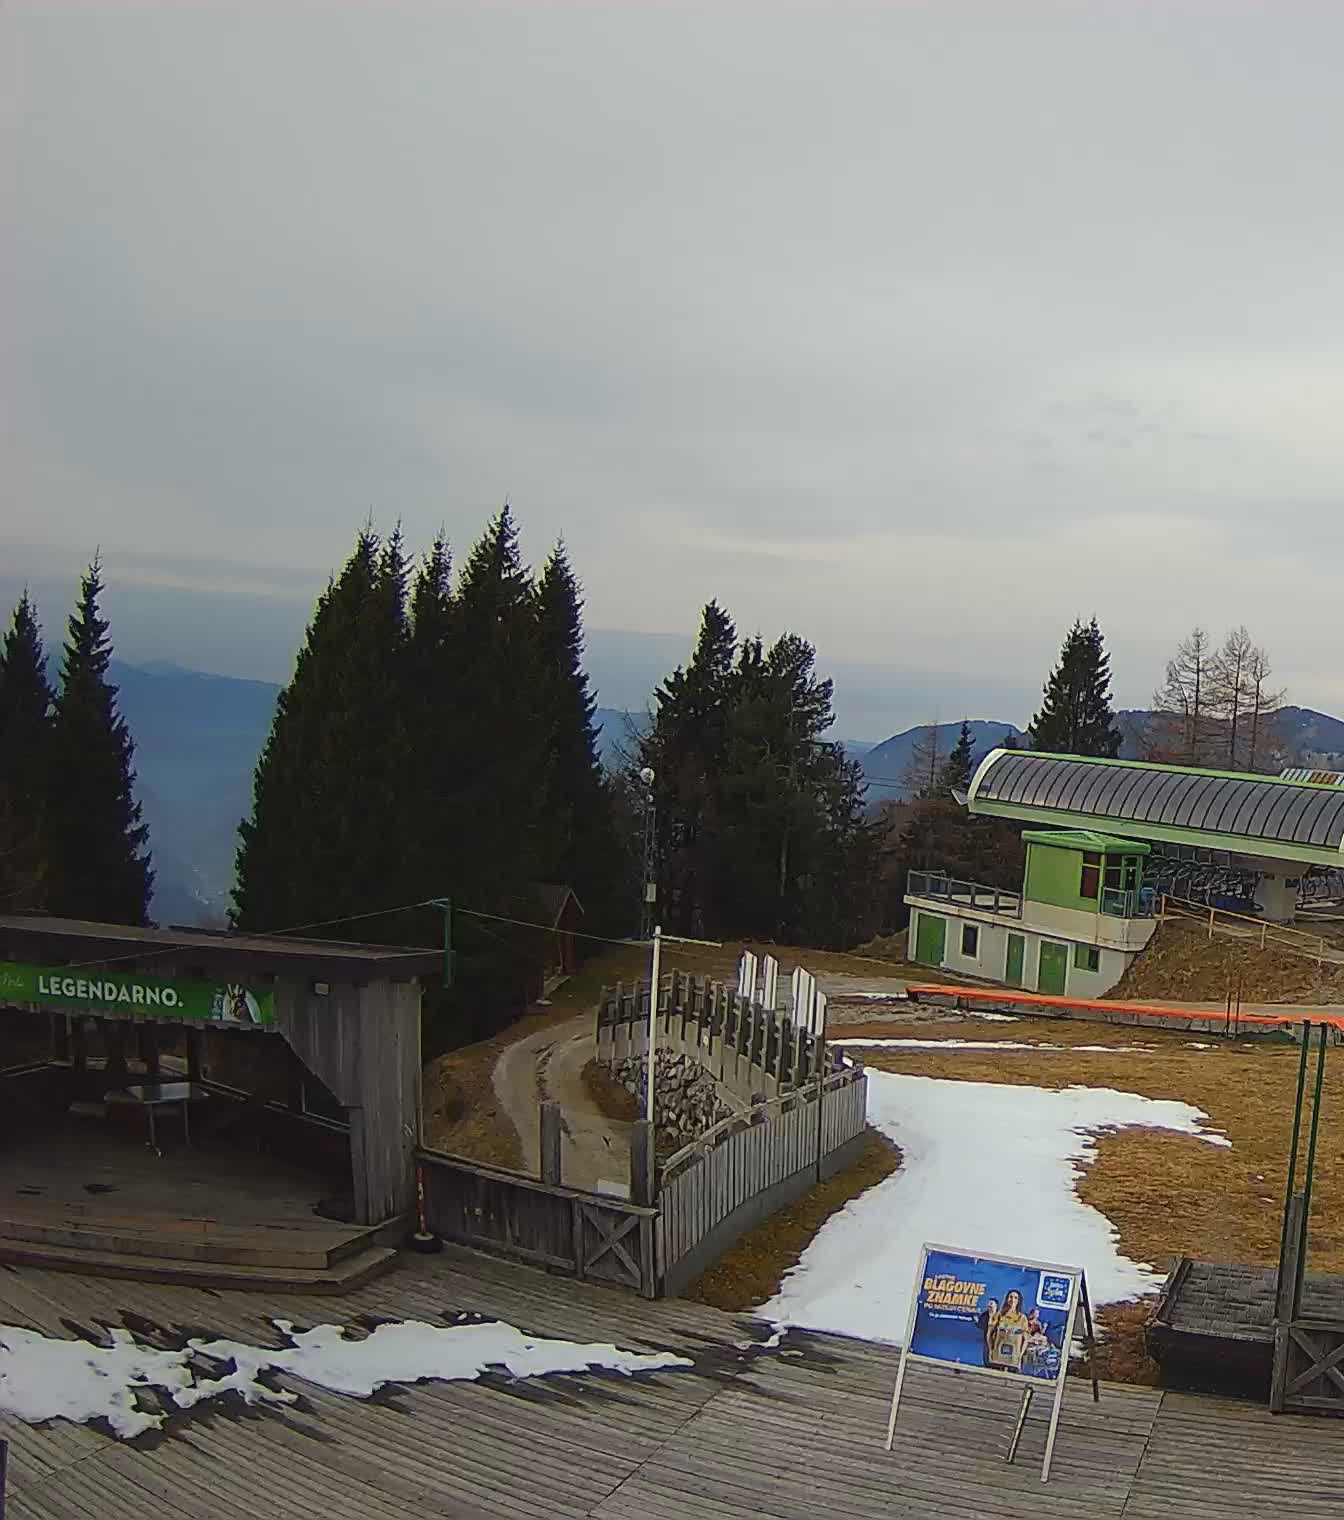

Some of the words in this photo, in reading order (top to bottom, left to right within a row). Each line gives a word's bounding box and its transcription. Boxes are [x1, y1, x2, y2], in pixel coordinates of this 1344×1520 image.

[39, 976, 183, 1007] LEGENDARNO.
[924, 1278, 986, 1295] BLAGOVNE
[926, 1291, 979, 1306] ZNAMKE
